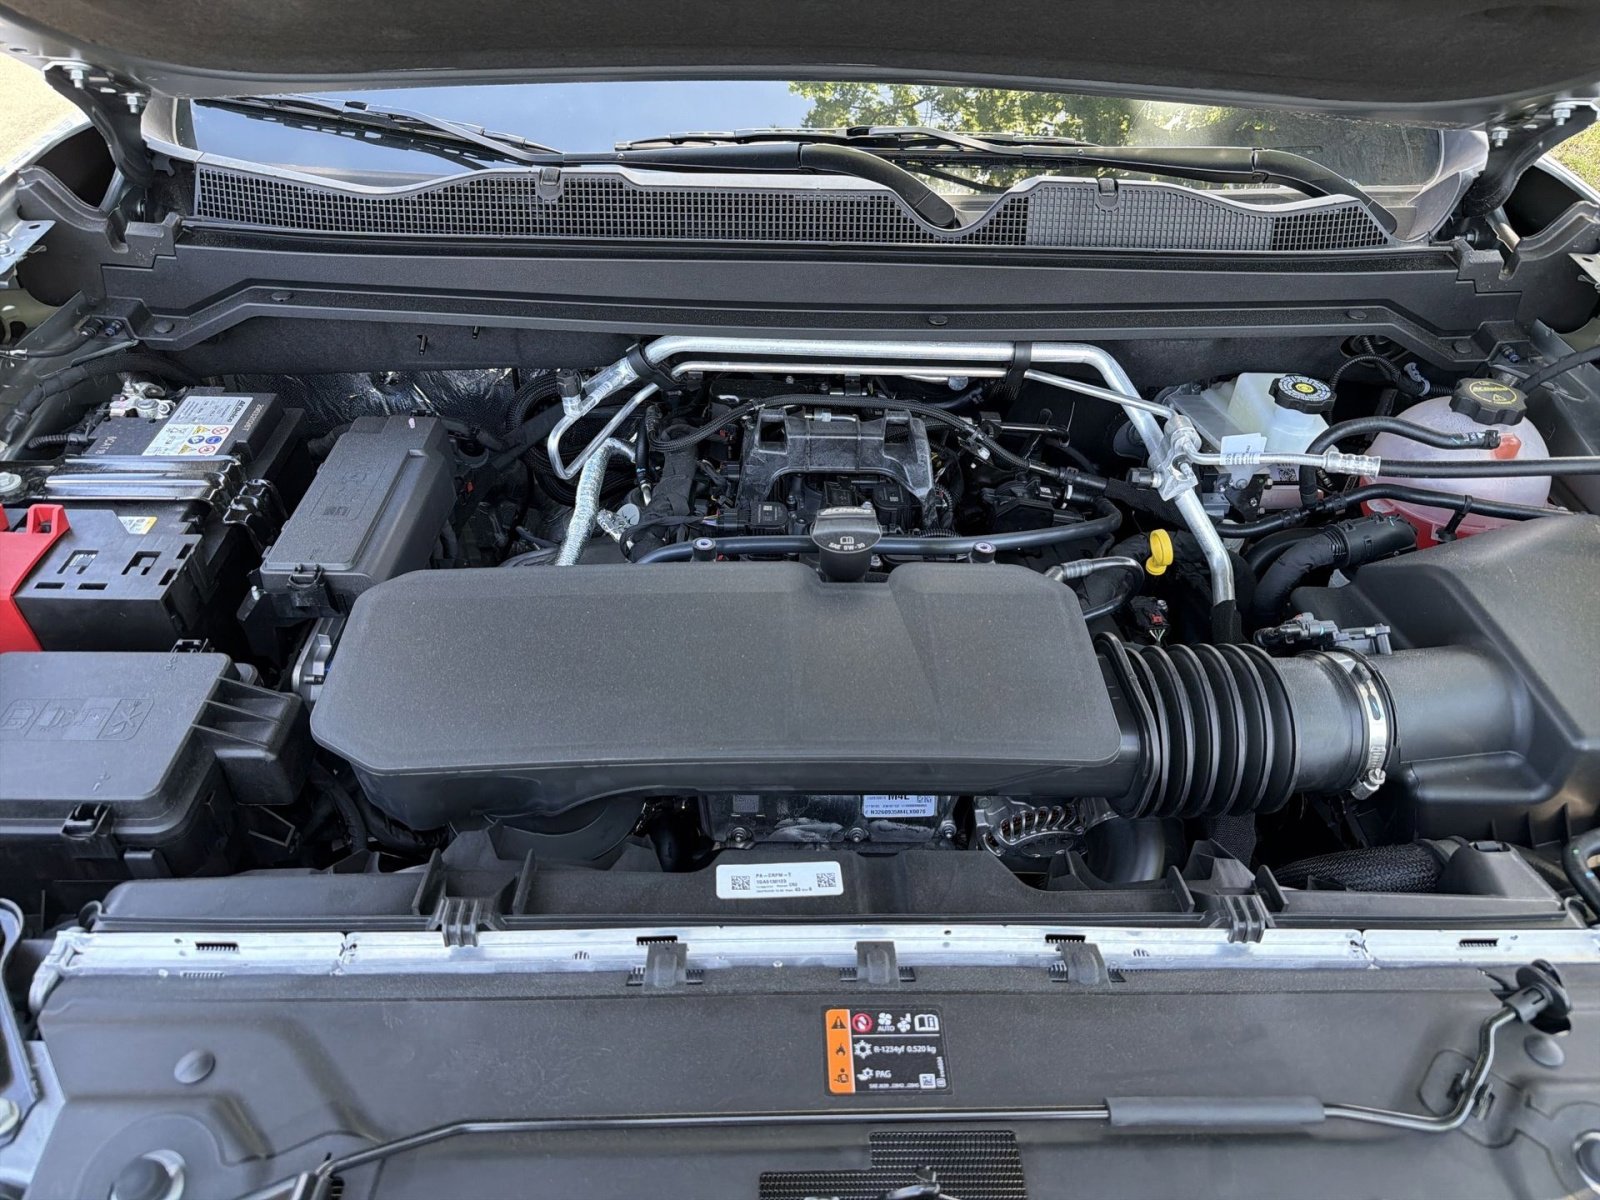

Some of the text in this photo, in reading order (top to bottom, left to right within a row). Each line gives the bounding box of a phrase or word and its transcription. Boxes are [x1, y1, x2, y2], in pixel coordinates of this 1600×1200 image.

[227, 400, 246, 422] ACDelco
[926, 1046, 937, 1054] kg
[875, 1069, 892, 1078] PAG
